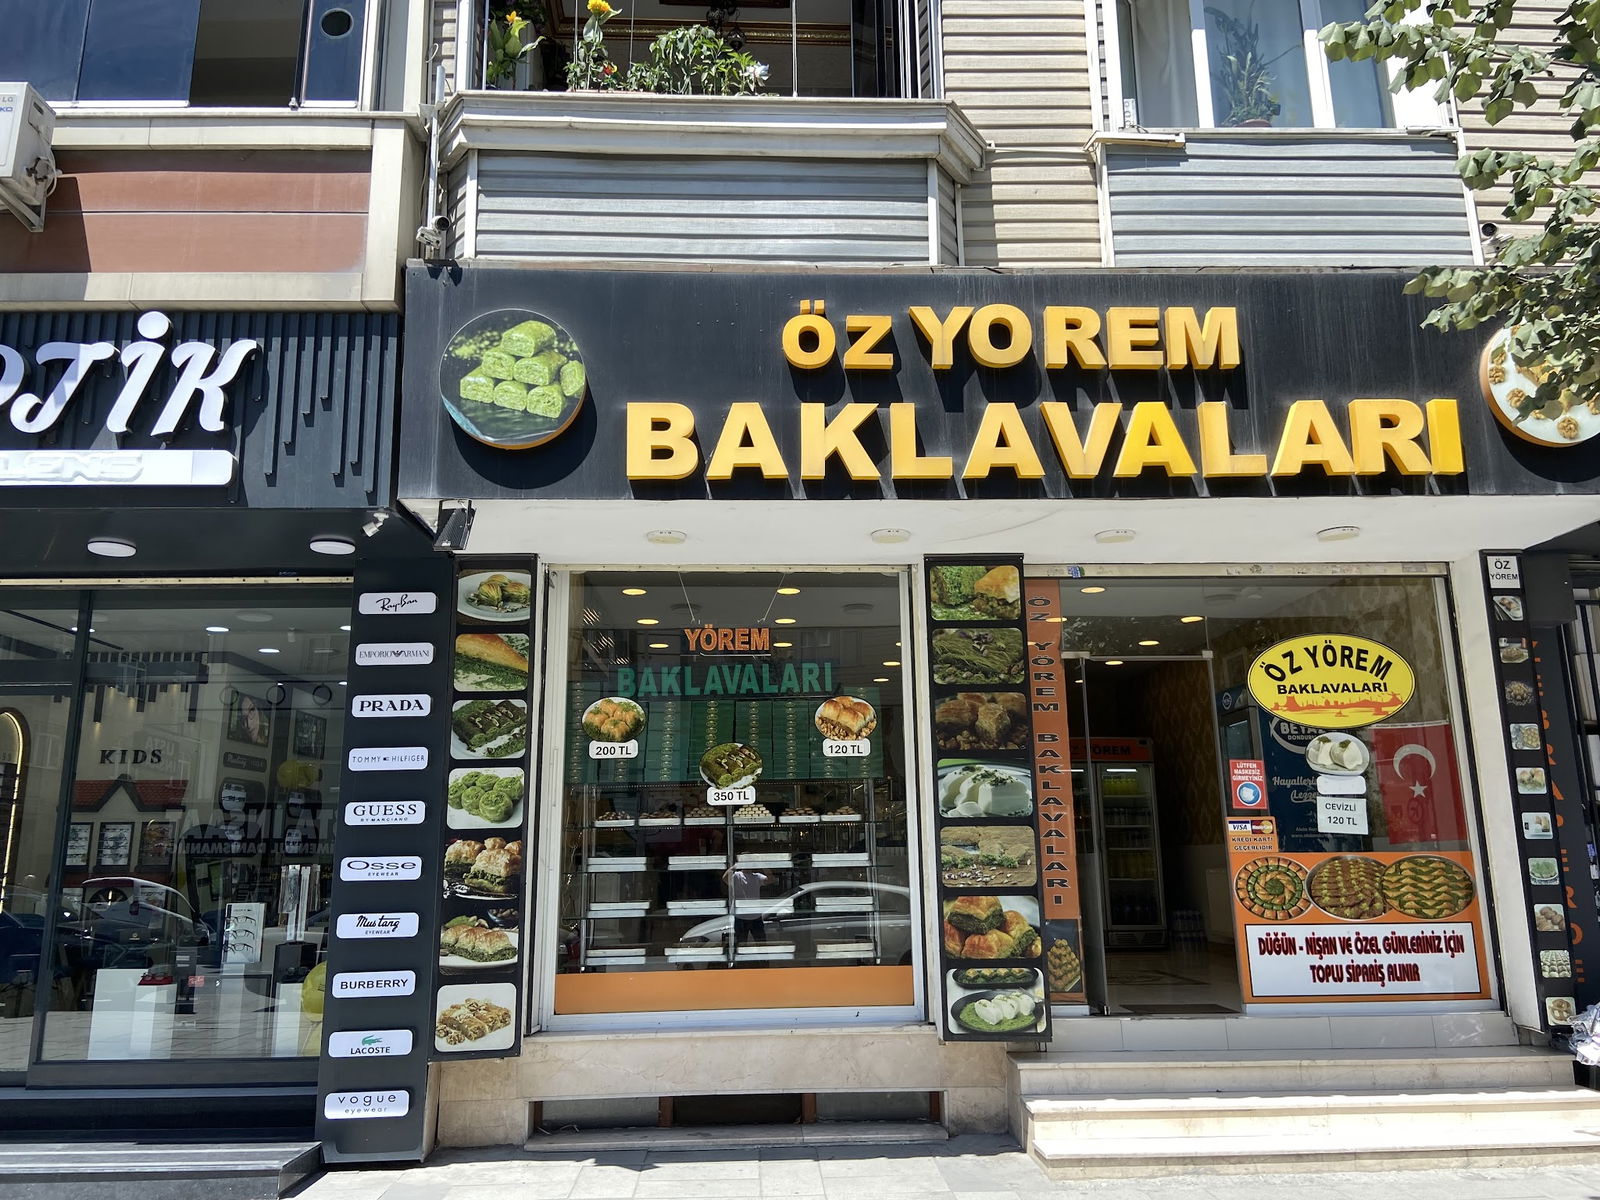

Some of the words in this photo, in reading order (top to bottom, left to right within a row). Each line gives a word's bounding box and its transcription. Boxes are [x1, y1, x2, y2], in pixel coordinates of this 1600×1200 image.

[782, 300, 894, 369] ÖZ
[908, 303, 1240, 370] YOREM
[626, 398, 1465, 480] BAKLAVALARI
[1495, 559, 1511, 570] ÖZ
[1490, 572, 1518, 581] YÖREM
[376, 594, 418, 612] Ray-Ban
[1027, 596, 1051, 622] ÖZ
[684, 624, 771, 651] YÖREM
[359, 650, 393, 659] EMPORIO
[402, 649, 430, 658] ARMANI
[1259, 650, 1303, 682] ÖZ
[1304, 640, 1393, 681] YÖREM
[617, 661, 833, 698] BAKLAVALARI
[1031, 641, 1060, 713] YÖREM
[1277, 682, 1388, 695] BAKLAVALARI
[359, 699, 424, 712] PRADA
[595, 746, 617, 756] 200
[619, 745, 632, 756] TL
[828, 744, 848, 755] 120
[850, 744, 863, 755] TL
[99, 748, 163, 765] KIDS
[352, 756, 381, 764] TOMMY
[713, 791, 734, 802] 350
[735, 790, 750, 801] TL
[353, 803, 417, 817] GUESS
[1325, 801, 1357, 812] CEVİZLİ
[1035, 732, 1071, 906] BAKLAVALARI
[1327, 816, 1344, 826] 120
[1346, 816, 1358, 826] TL
[347, 860, 417, 870] Osse
[1257, 932, 1297, 956] DÜĞÜN
[1305, 932, 1336, 960] NİŞAN
[1337, 936, 1352, 954] VE
[1354, 931, 1381, 955] ÖZEL
[1382, 930, 1442, 954] GÜNLERİNİZ
[1443, 930, 1464, 958] İÇİN
[1310, 964, 1343, 983] TOPLU
[1345, 959, 1386, 987] SİPARİŞ
[1387, 963, 1421, 983] ALINIR
[340, 979, 408, 990] BURBERRY
[350, 1046, 391, 1055] LACOSTE
[338, 1094, 397, 1106] vogue
